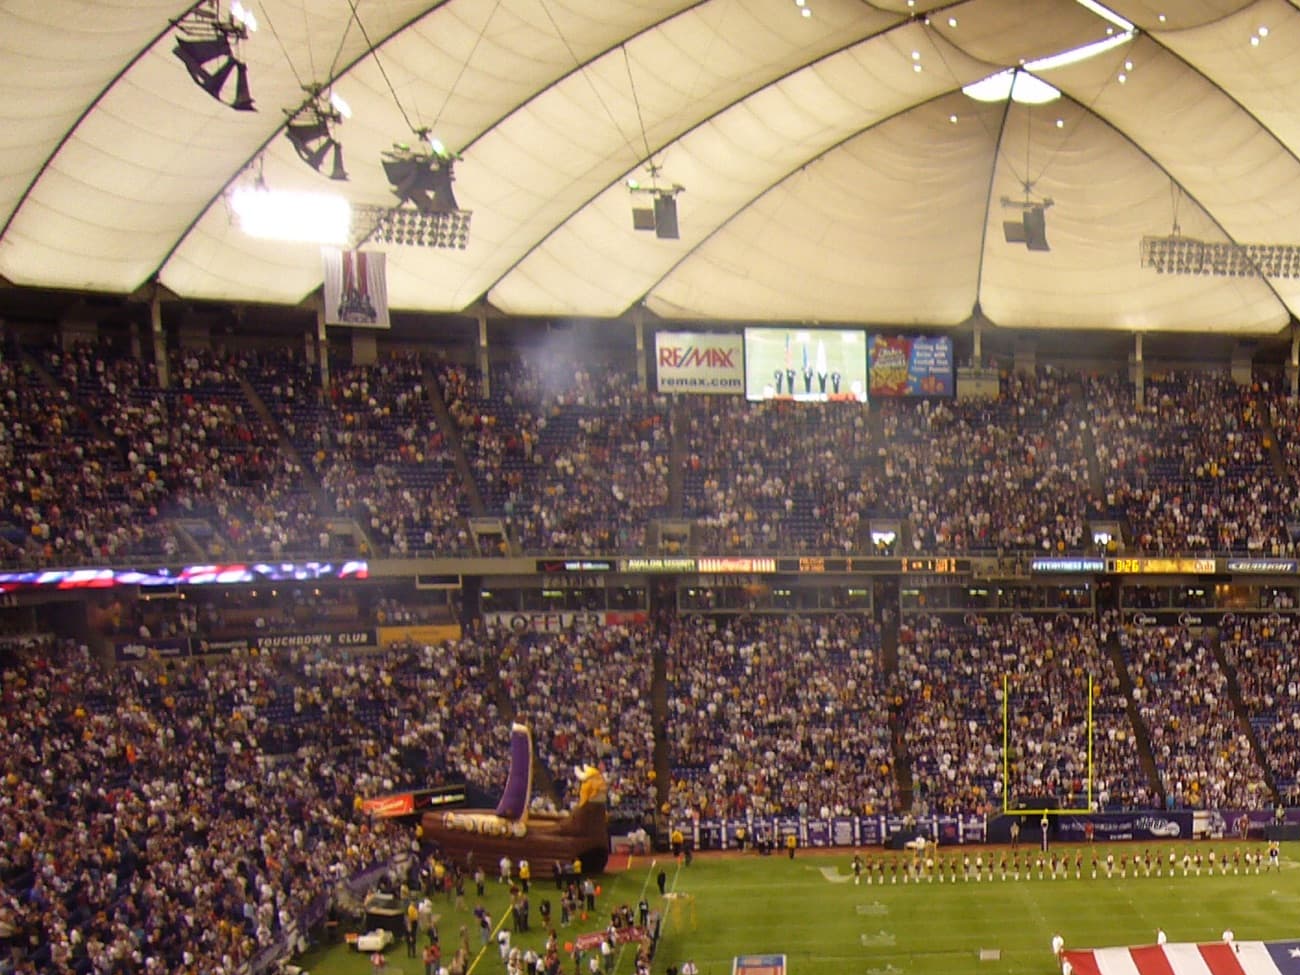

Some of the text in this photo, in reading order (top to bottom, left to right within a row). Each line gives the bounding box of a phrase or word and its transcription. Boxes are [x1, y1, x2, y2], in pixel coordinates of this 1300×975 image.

[660, 346, 734, 368] RE/MAX
[661, 376, 741, 387] remax.com
[257, 632, 369, 648] TOUCHDOWN CLUB
